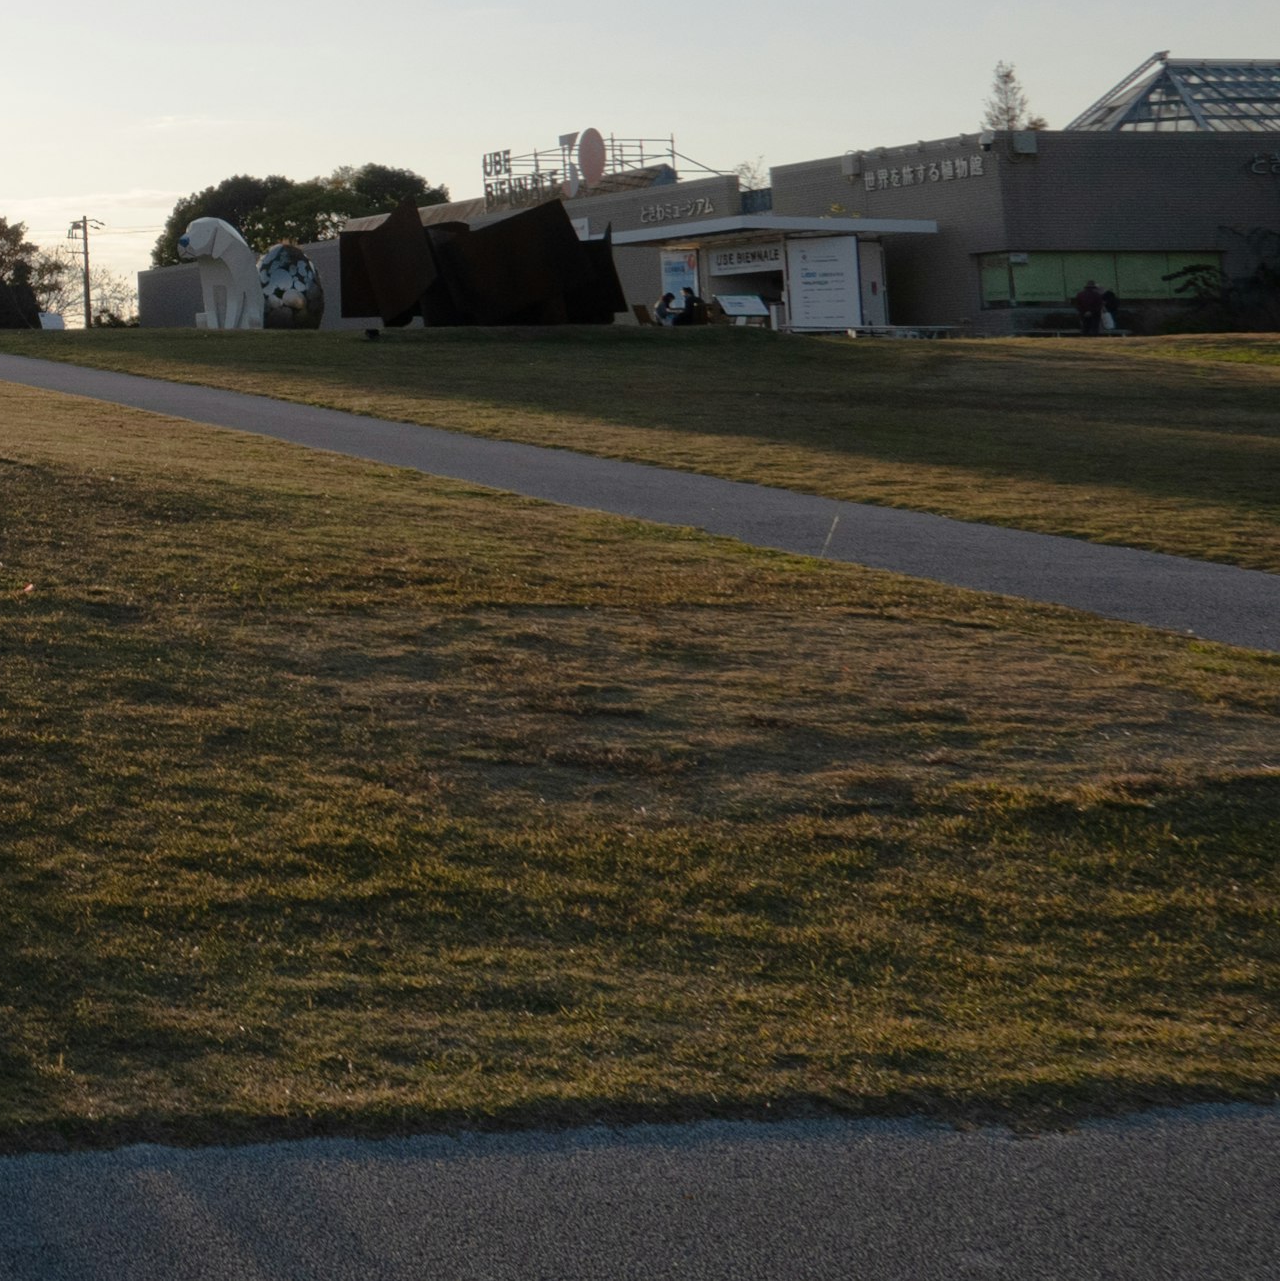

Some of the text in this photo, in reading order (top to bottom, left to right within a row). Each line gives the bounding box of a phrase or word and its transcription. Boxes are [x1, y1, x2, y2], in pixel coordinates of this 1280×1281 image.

[483, 149, 511, 176] UBE
[864, 155, 984, 192] 世界を旅する植物館
[640, 197, 714, 223] ときわミュージアム
[716, 249, 780, 266] UBE BIENNALE
